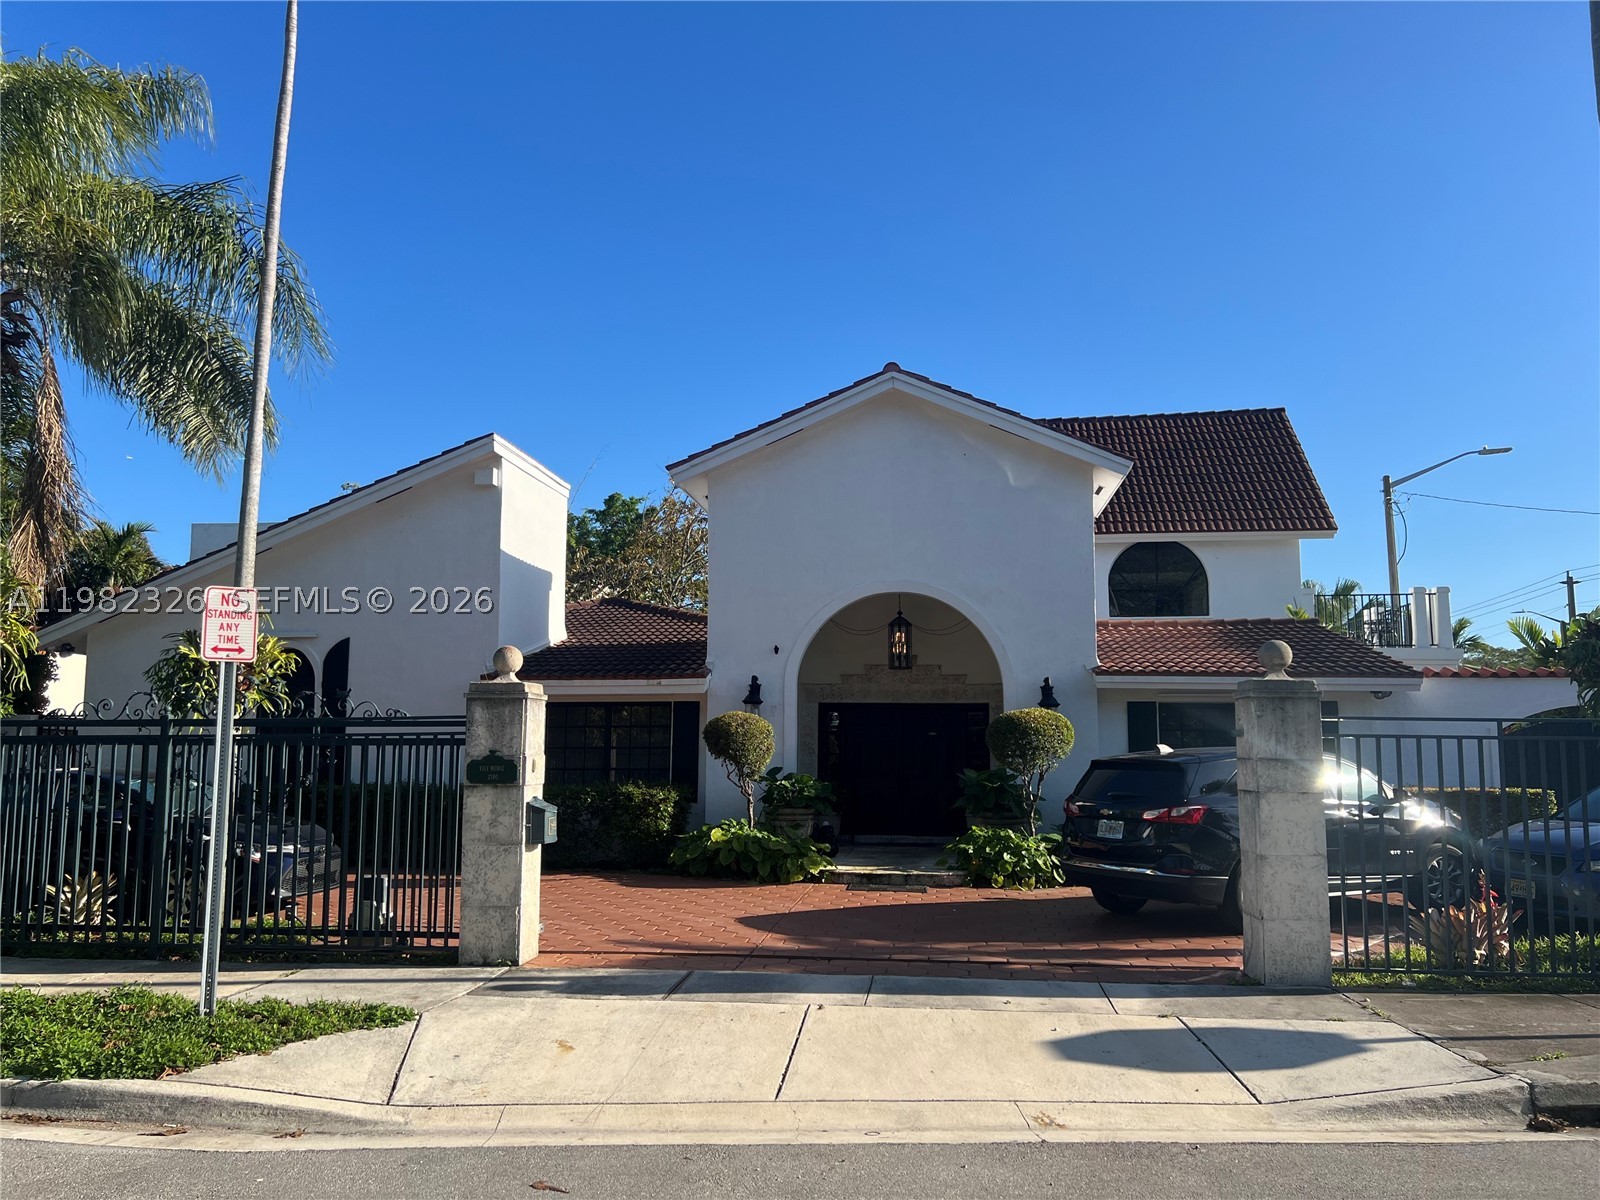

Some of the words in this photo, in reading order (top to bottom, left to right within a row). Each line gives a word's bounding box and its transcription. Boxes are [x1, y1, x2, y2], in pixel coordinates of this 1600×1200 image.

[221, 593, 241, 608] NO
[207, 608, 253, 621] STANDING
[218, 622, 240, 632] ANY
[218, 634, 240, 645] TIME
